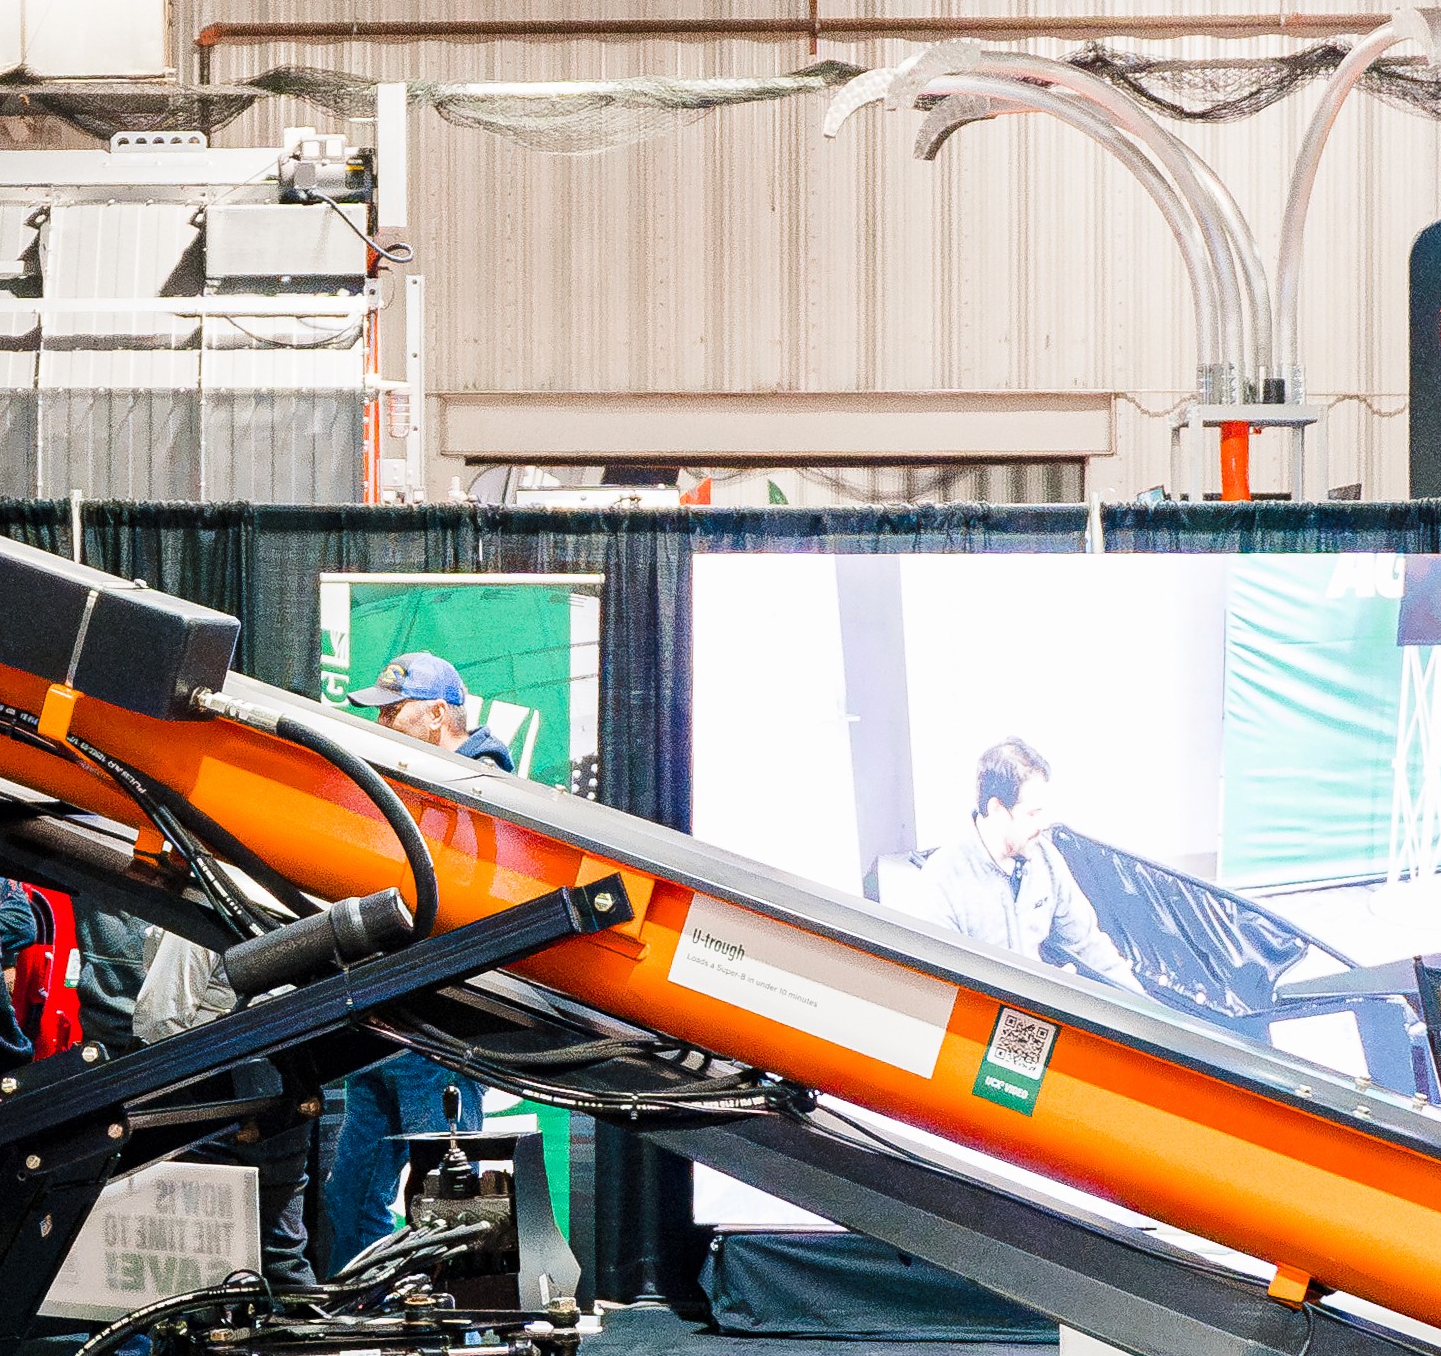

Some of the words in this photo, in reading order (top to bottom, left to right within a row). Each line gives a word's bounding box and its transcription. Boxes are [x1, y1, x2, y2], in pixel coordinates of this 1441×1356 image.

[692, 928, 745, 962] U-trough
[687, 952, 709, 968] Loads
[755, 980, 778, 993] under
[788, 991, 819, 1008] minutes
